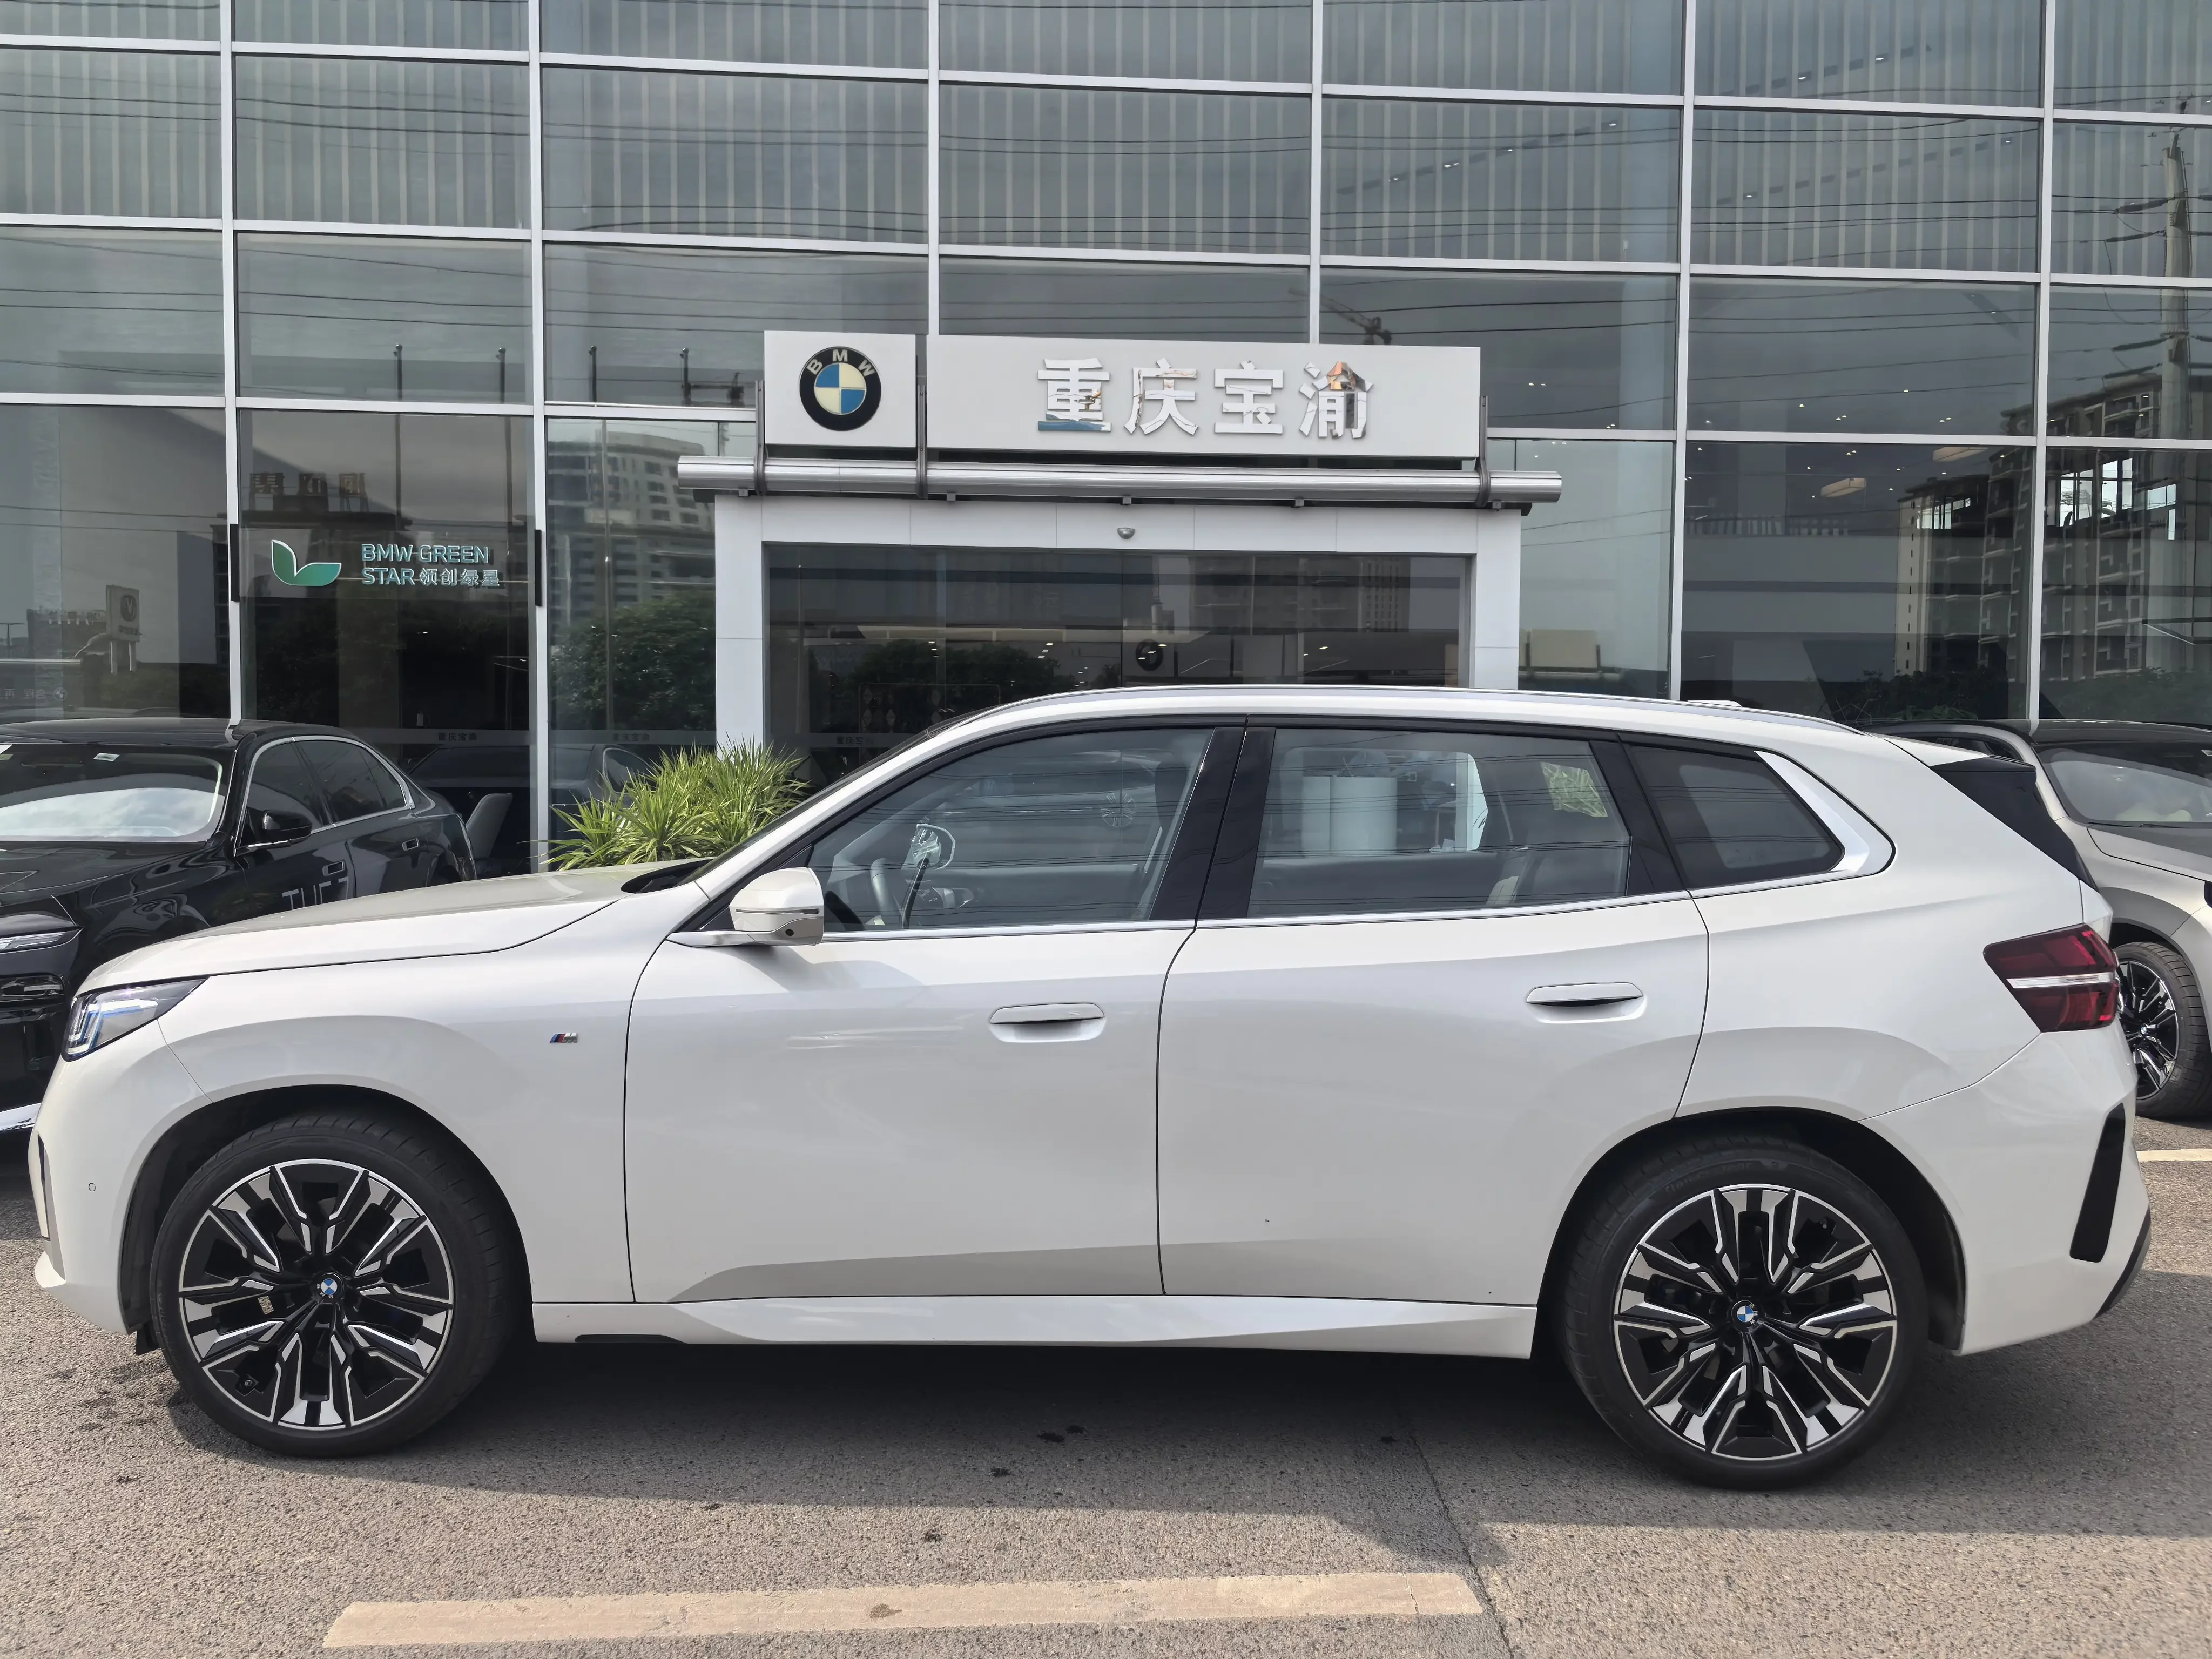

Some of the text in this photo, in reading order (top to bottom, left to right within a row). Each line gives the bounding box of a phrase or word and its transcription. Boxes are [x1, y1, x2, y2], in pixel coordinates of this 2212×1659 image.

[806, 349, 875, 376] BMW
[1037, 358, 1374, 439] 重庆宝渝
[361, 544, 488, 563] BMW GREEN
[361, 568, 500, 586] STAR 领创绿星
[316, 1283, 334, 1299] BMW
